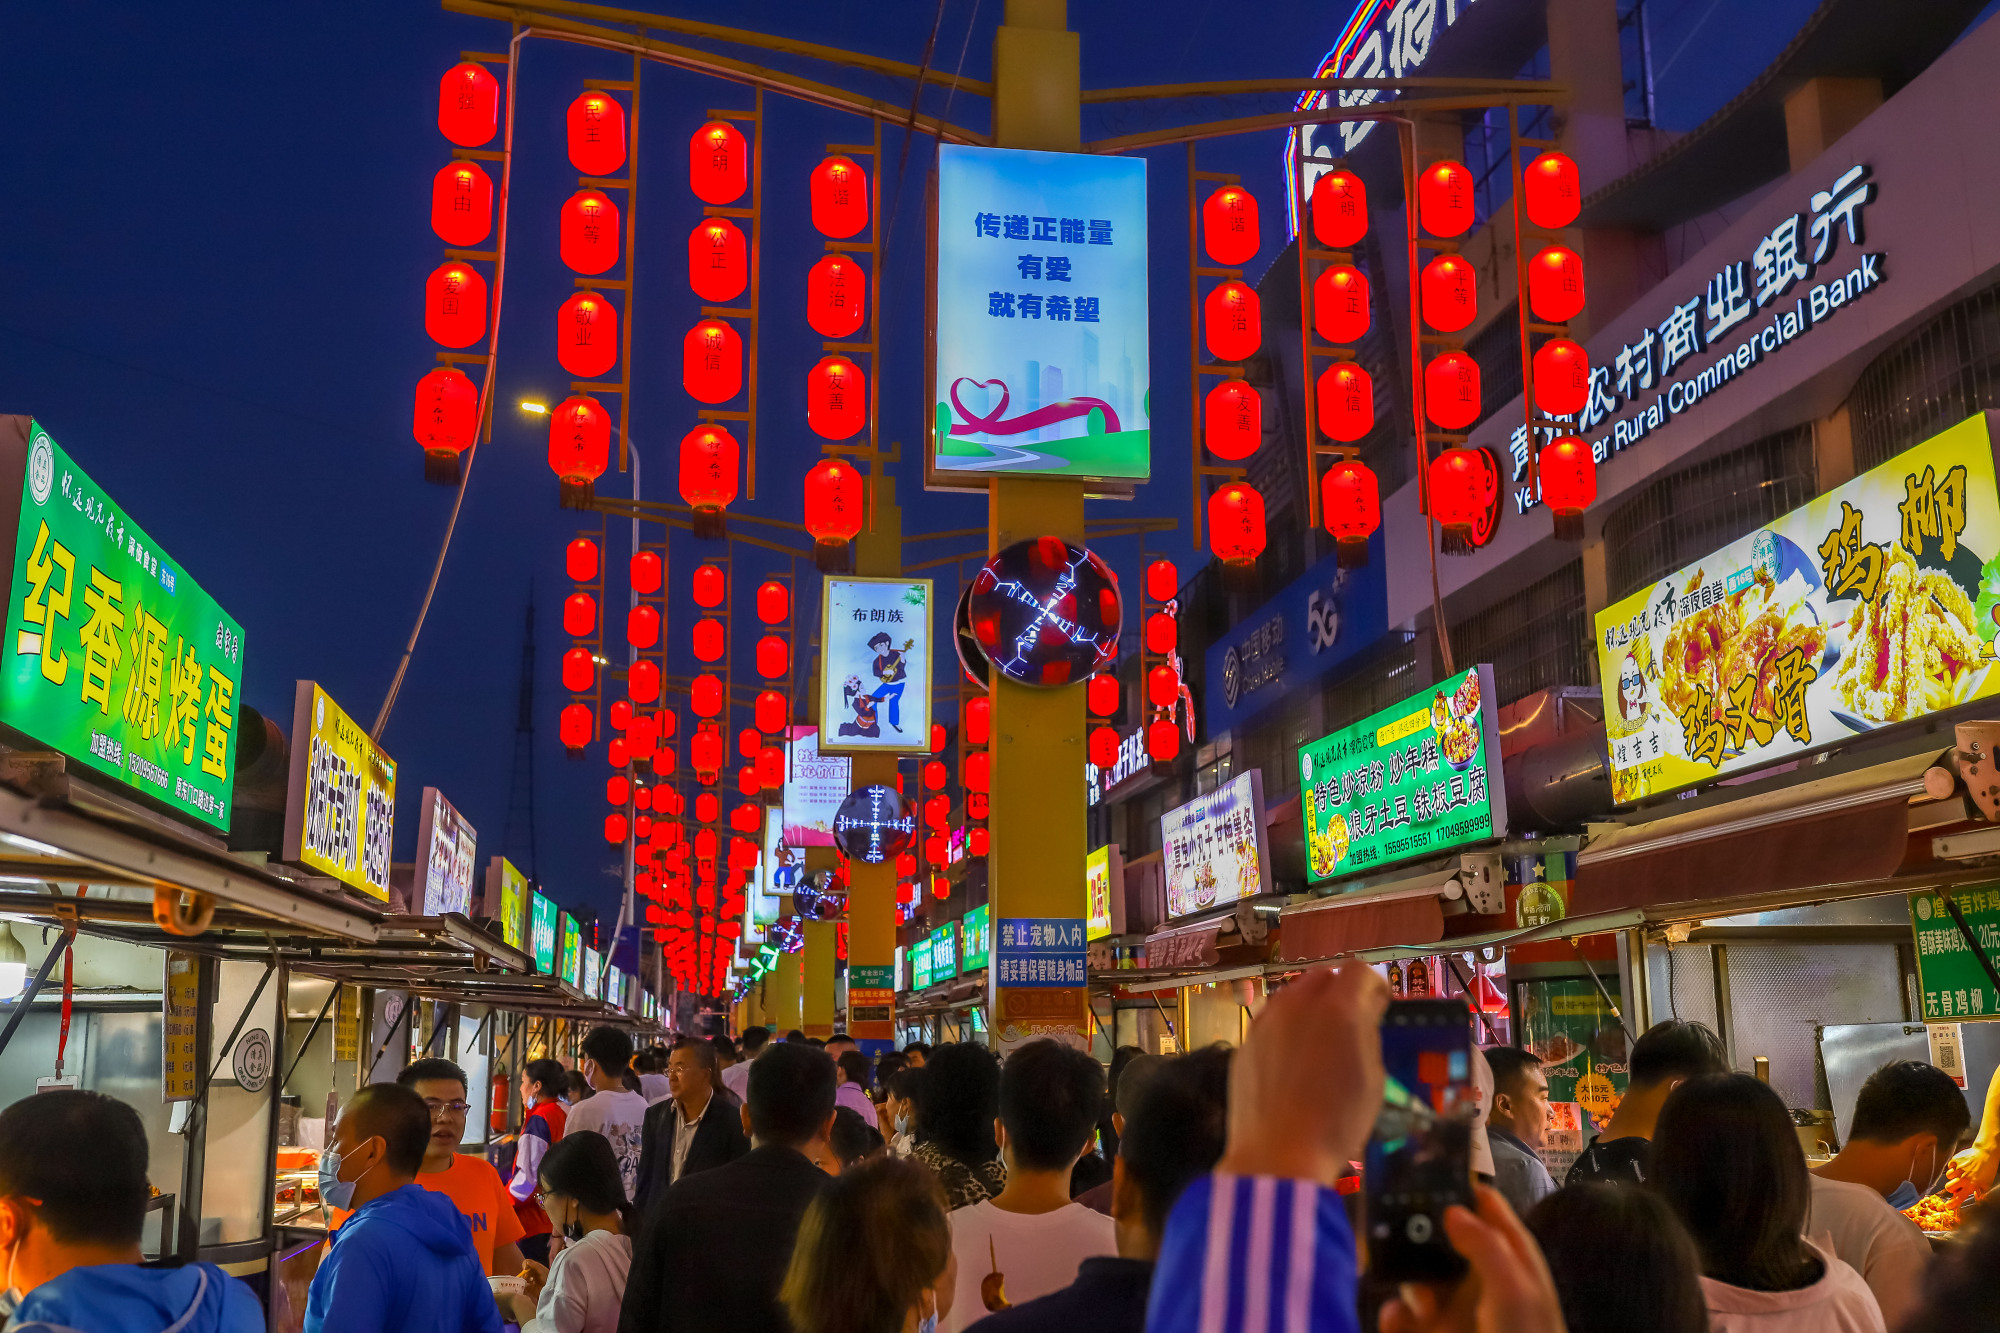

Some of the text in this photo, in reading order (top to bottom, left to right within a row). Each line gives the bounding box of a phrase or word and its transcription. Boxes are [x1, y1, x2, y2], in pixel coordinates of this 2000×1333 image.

[585, 104, 601, 143] 民主
[712, 135, 728, 171] 文明
[454, 175, 471, 212] 自由
[832, 169, 849, 206] 和谐
[1339, 182, 1356, 216] 文明
[1448, 172, 1463, 209] 民主
[584, 205, 600, 244] 平等
[975, 212, 1113, 245] 传递正能量
[1228, 198, 1246, 233] 和谐
[710, 232, 727, 269] 公正
[1017, 254, 1072, 282] 有爱
[829, 270, 845, 308] 法治
[1454, 268, 1469, 305] 平等
[1562, 257, 1577, 293] 自由
[443, 277, 460, 315] 爱国
[988, 291, 1100, 323] 就有希望
[1231, 295, 1247, 331] 法治
[1345, 277, 1361, 314] 公正
[575, 307, 592, 346] 敬业
[705, 333, 722, 371] 诚信
[1615, 395, 1664, 450] Rural
[1668, 299, 1804, 414] Commercial
[1809, 254, 1879, 323] Bank
[828, 372, 845, 411] 友善
[1345, 377, 1361, 412] 诚信
[1458, 366, 1472, 402] 敬业
[1236, 395, 1251, 431] 友善
[127, 535, 158, 578] 深夜食堂
[1679, 579, 1725, 618] 深夜食堂
[1728, 567, 1754, 593] 西16号
[852, 607, 904, 624] 布朗族
[1308, 590, 1338, 655] 5G
[17, 517, 234, 785] 纪香源烤蛋
[1241, 612, 1283, 664] 中国移动
[1617, 731, 1659, 763] 煌吉吉
[1314, 736, 1440, 814] 特色炒凉粉 炒年糕
[1349, 796, 1411, 842] 狼牙土豆
[1414, 765, 1487, 822] 铁板豆腐
[1384, 831, 1432, 856] 15595515551
[1436, 813, 1490, 843] 17049599999
[1933, 889, 2000, 918] 煌吉炸鸡
[1002, 924, 1082, 947] 禁止宠物入内
[1000, 959, 1084, 982] 请妥善保管随身物品
[1926, 988, 1983, 1016] 无骨鸡柳
[246, 1034, 259, 1044] NING
[238, 1066, 246, 1081] QING
[246, 1080, 258, 1088] ZHEN
[1595, 1062, 1629, 1074] 特色
